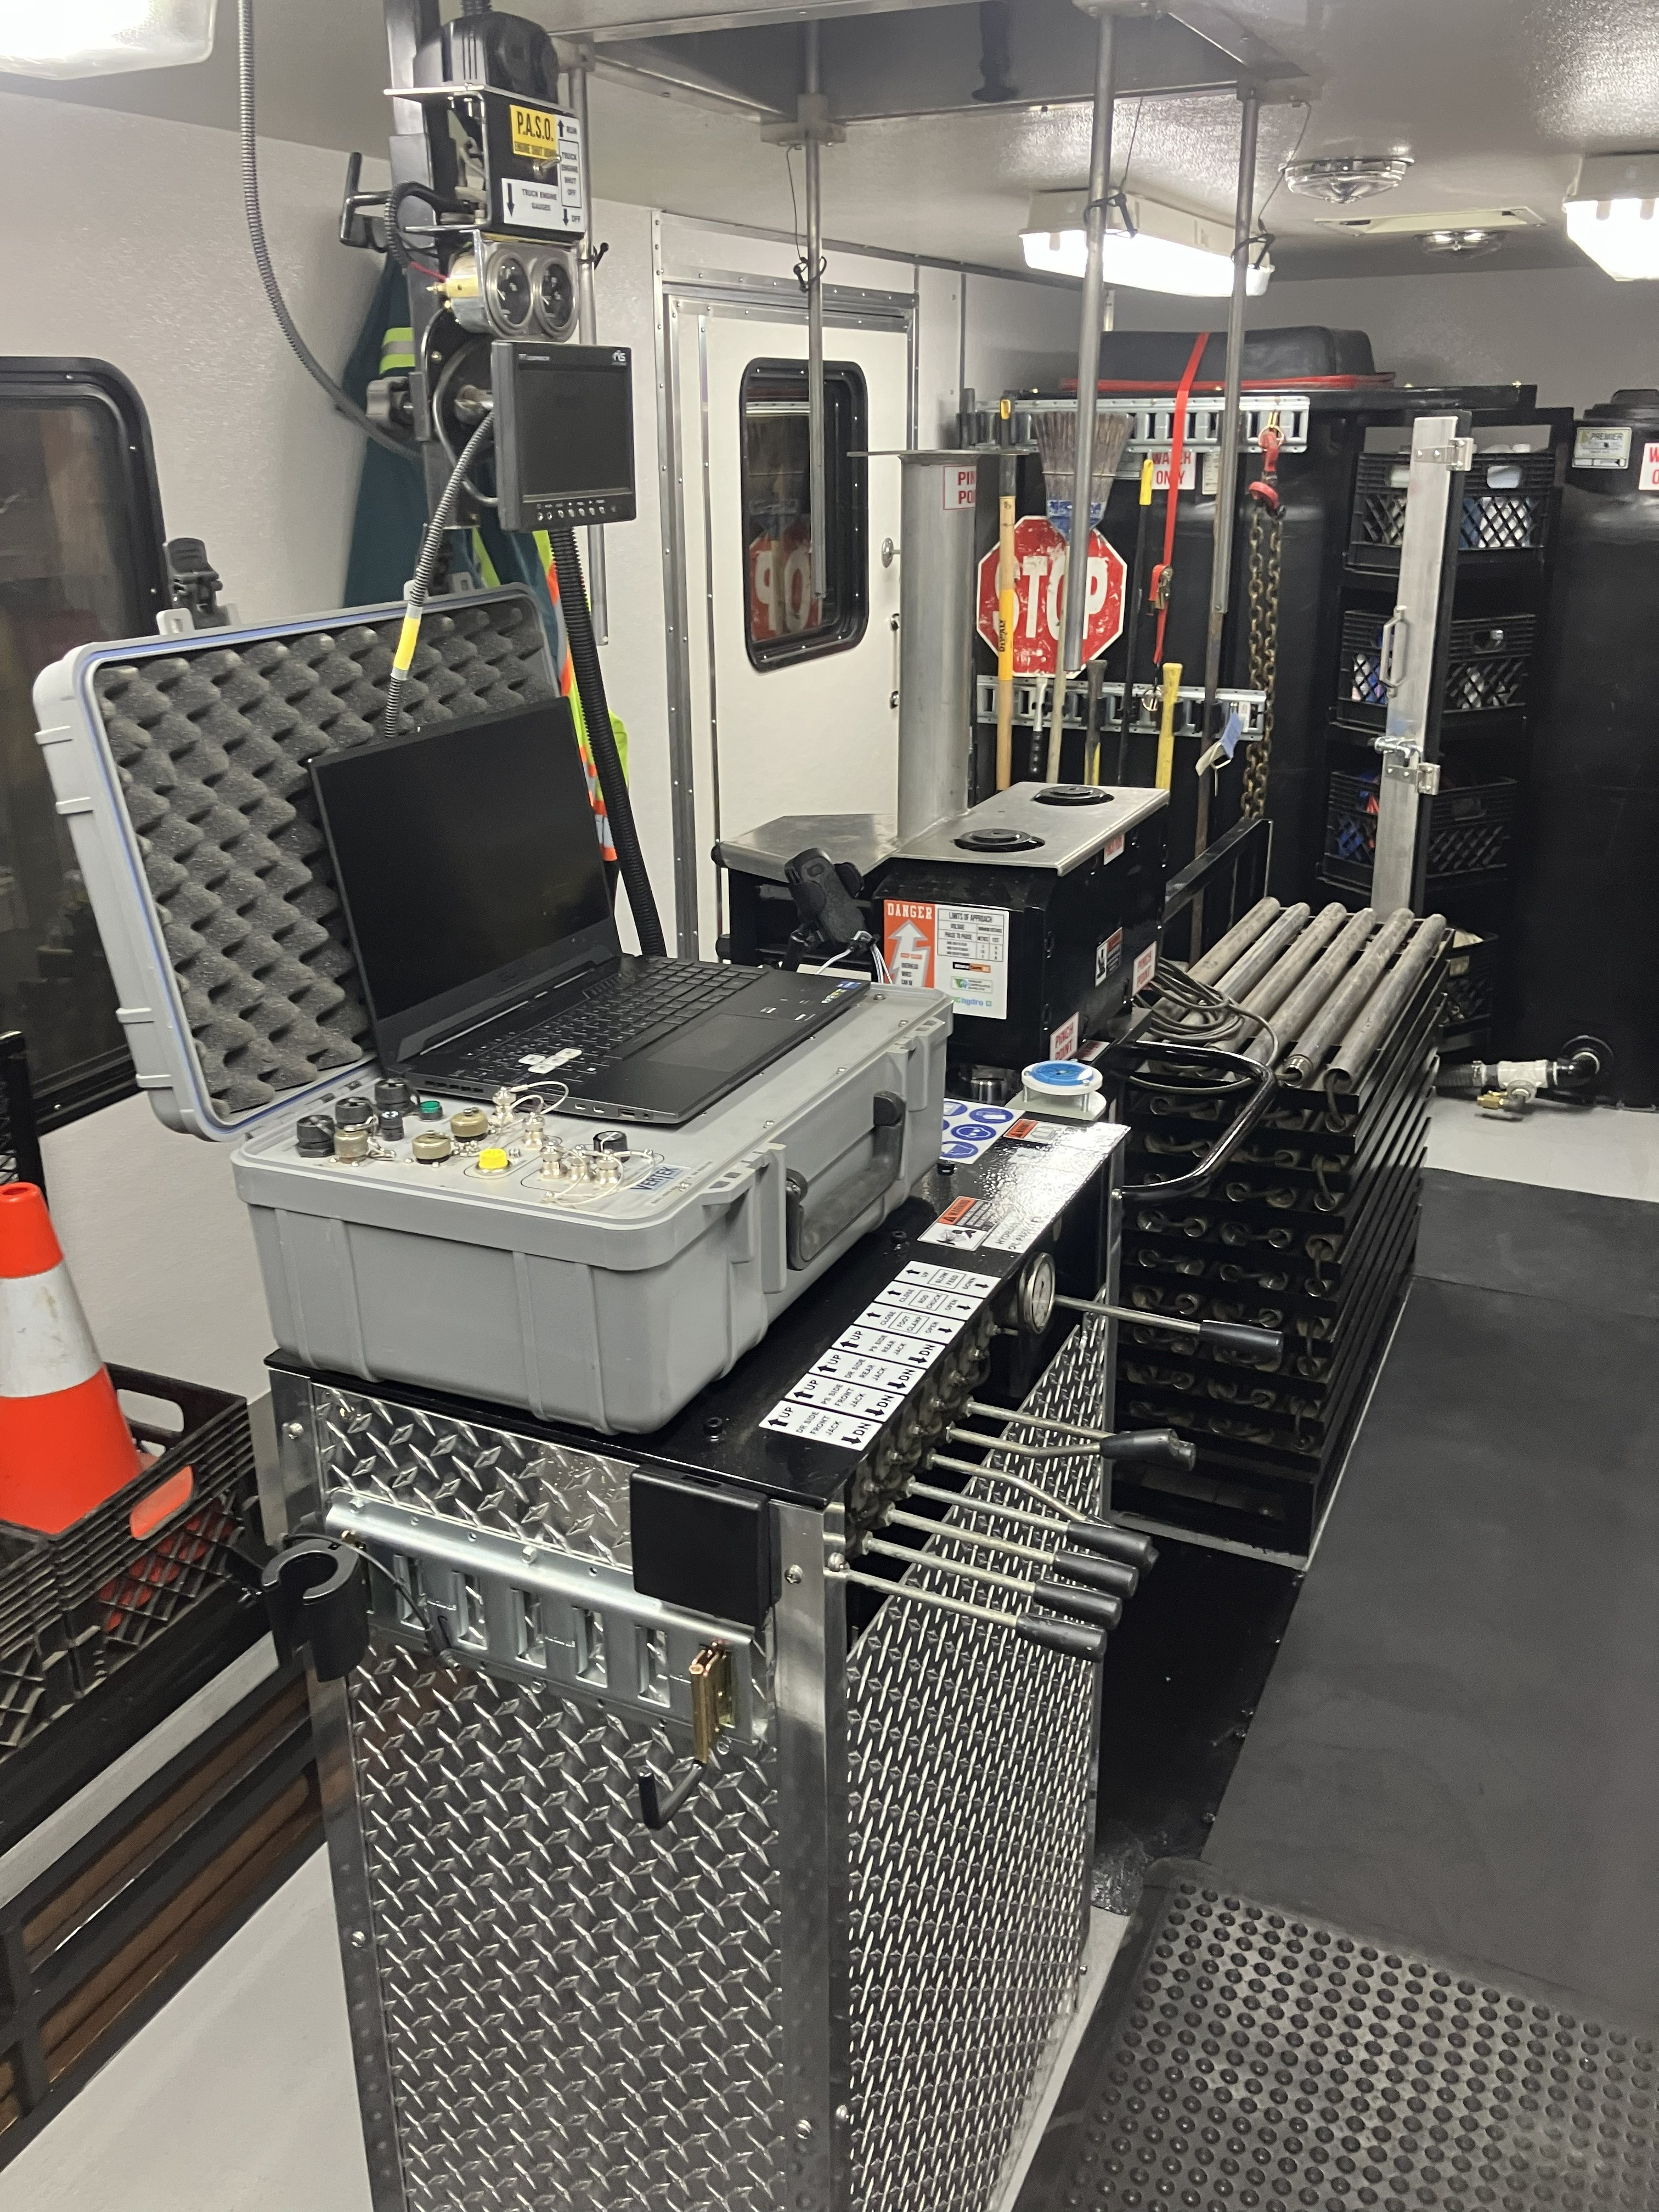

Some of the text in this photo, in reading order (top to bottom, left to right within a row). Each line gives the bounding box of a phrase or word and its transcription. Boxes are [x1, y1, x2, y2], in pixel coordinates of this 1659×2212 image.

[516, 111, 554, 142] P.A.S.O.
[1156, 470, 1185, 484] ONY
[887, 903, 933, 919] DANGER
[629, 1166, 679, 1190] VERTEK
[850, 1331, 863, 1340] UP
[894, 1343, 906, 1355] JACK
[918, 1344, 935, 1356] DN
[827, 1355, 841, 1364] UP
[872, 1367, 887, 1381] JACK
[898, 1369, 916, 1381] DN
[804, 1380, 819, 1390] UP
[834, 1388, 854, 1406] FRONT
[850, 1393, 866, 1407] JACK
[876, 1395, 894, 1408] DN
[779, 1407, 793, 1418] UP
[810, 1415, 830, 1434] FRONT
[826, 1421, 841, 1435] JACK
[852, 1423, 871, 1436] DN
